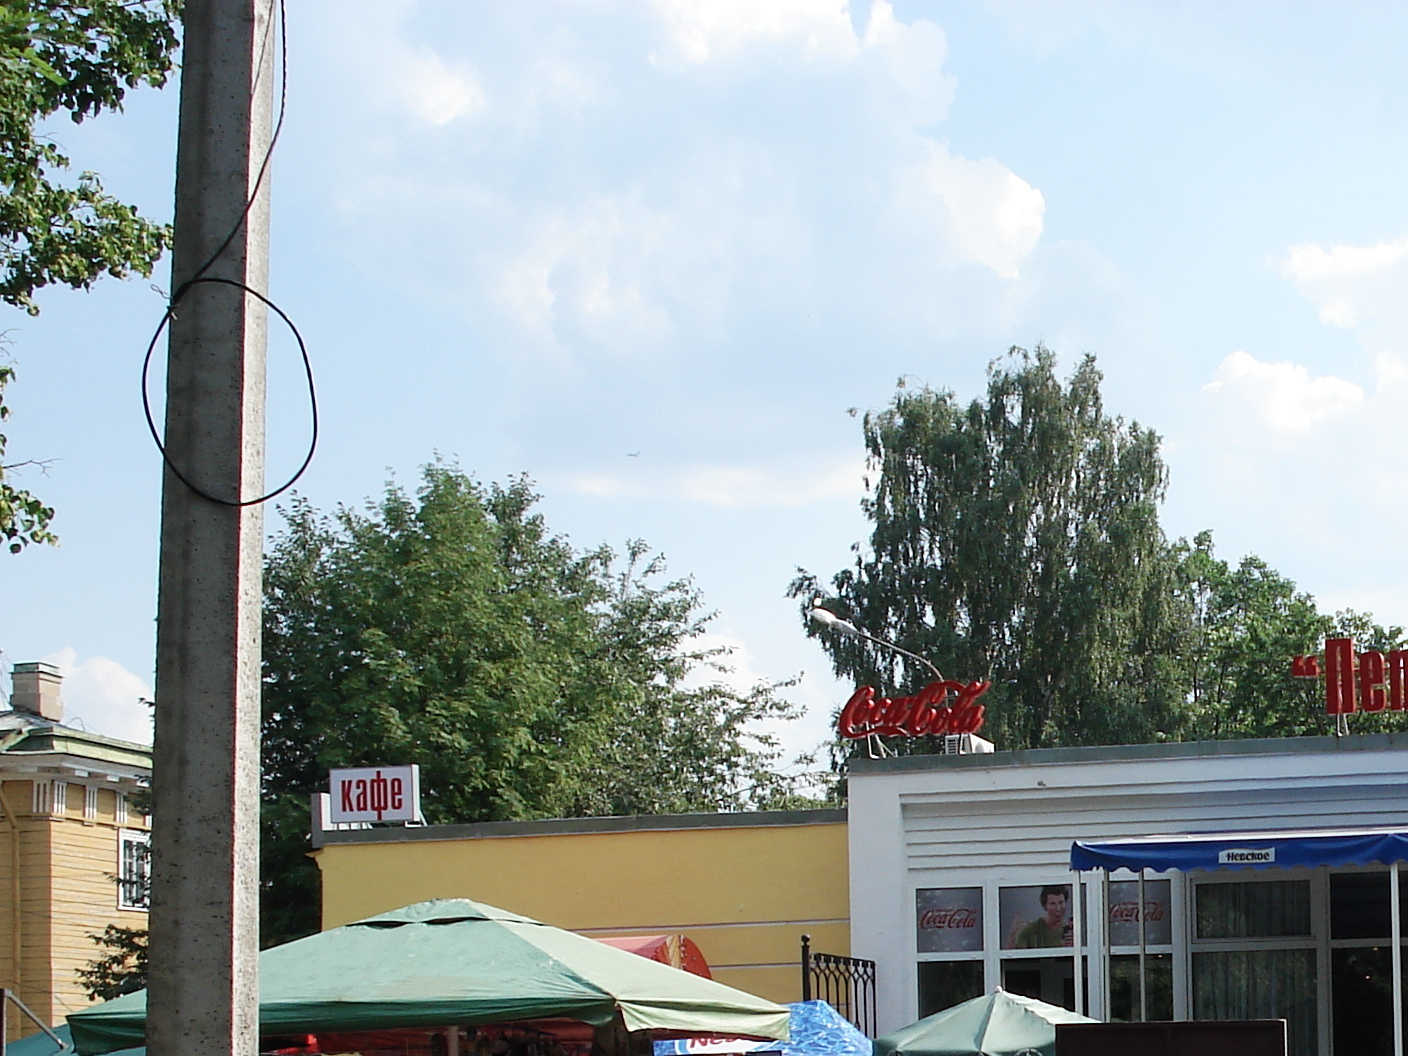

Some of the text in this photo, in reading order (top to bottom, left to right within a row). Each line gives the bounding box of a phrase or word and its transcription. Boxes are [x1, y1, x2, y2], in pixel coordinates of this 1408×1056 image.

[839, 679, 991, 739] Coca-Cola
[341, 770, 402, 820] кафе
[920, 908, 977, 929] Coca-Cola
